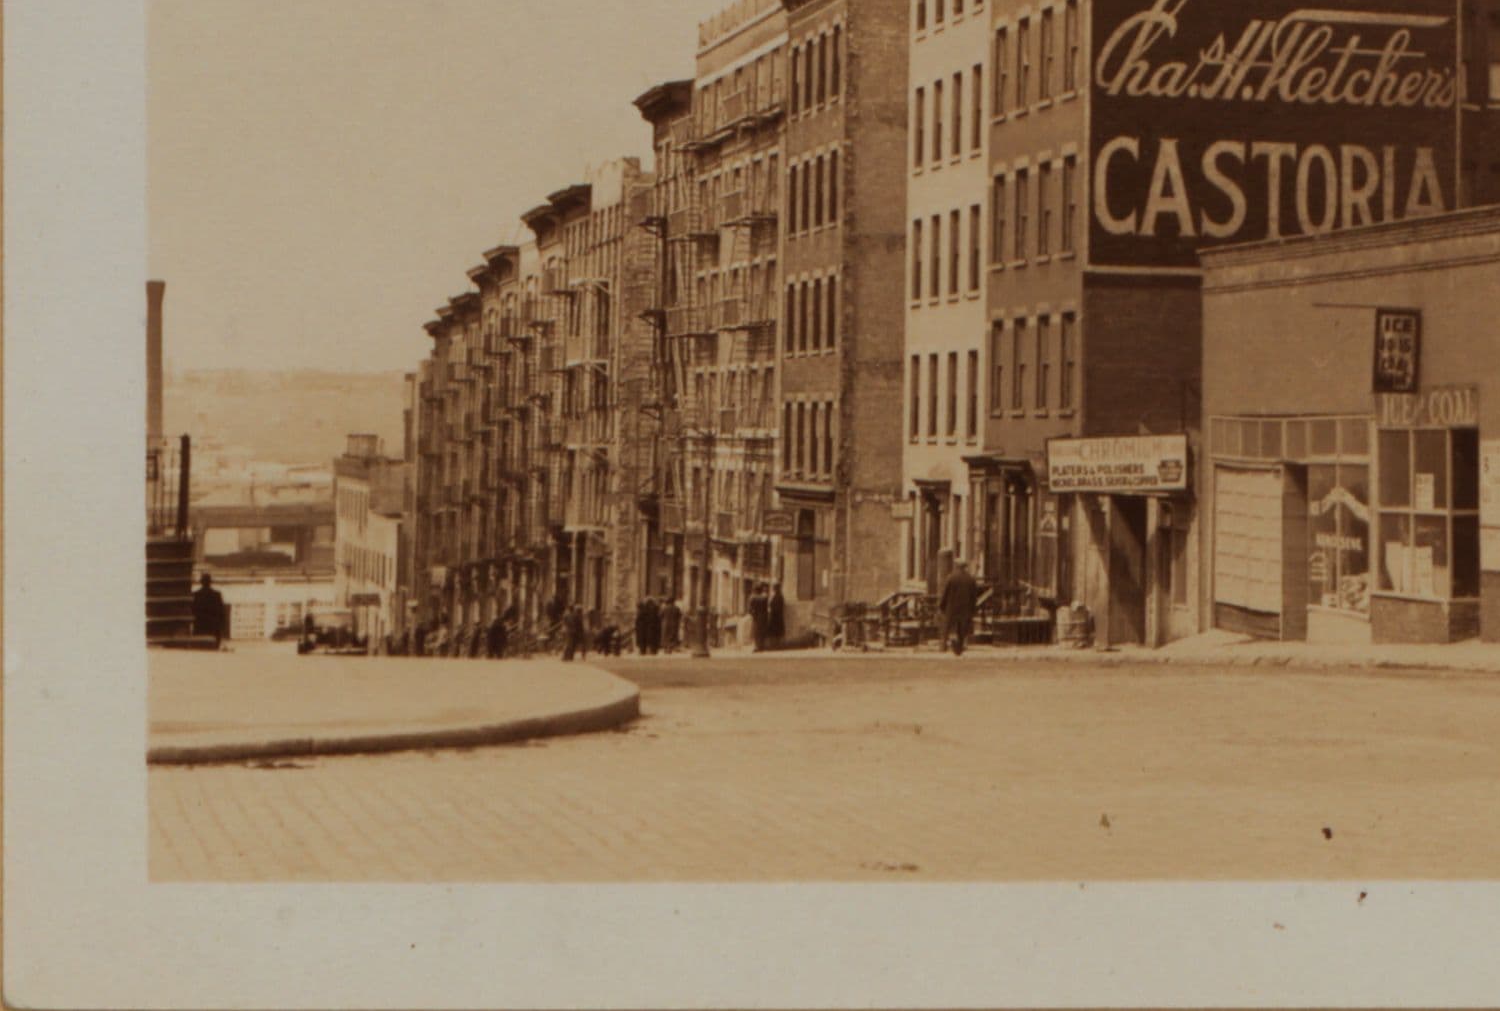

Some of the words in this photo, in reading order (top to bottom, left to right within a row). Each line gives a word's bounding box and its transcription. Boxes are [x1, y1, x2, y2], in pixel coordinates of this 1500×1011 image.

[1255, 8, 1457, 108] Fletcher's
[1093, 135, 1447, 244] CASTORIA
[1384, 317, 1413, 333] ICE
[1382, 392, 1412, 427] ICE
[1428, 389, 1478, 427] COAL
[1051, 465, 1089, 476] PLATERS
[1097, 463, 1145, 475] POLISHERS
